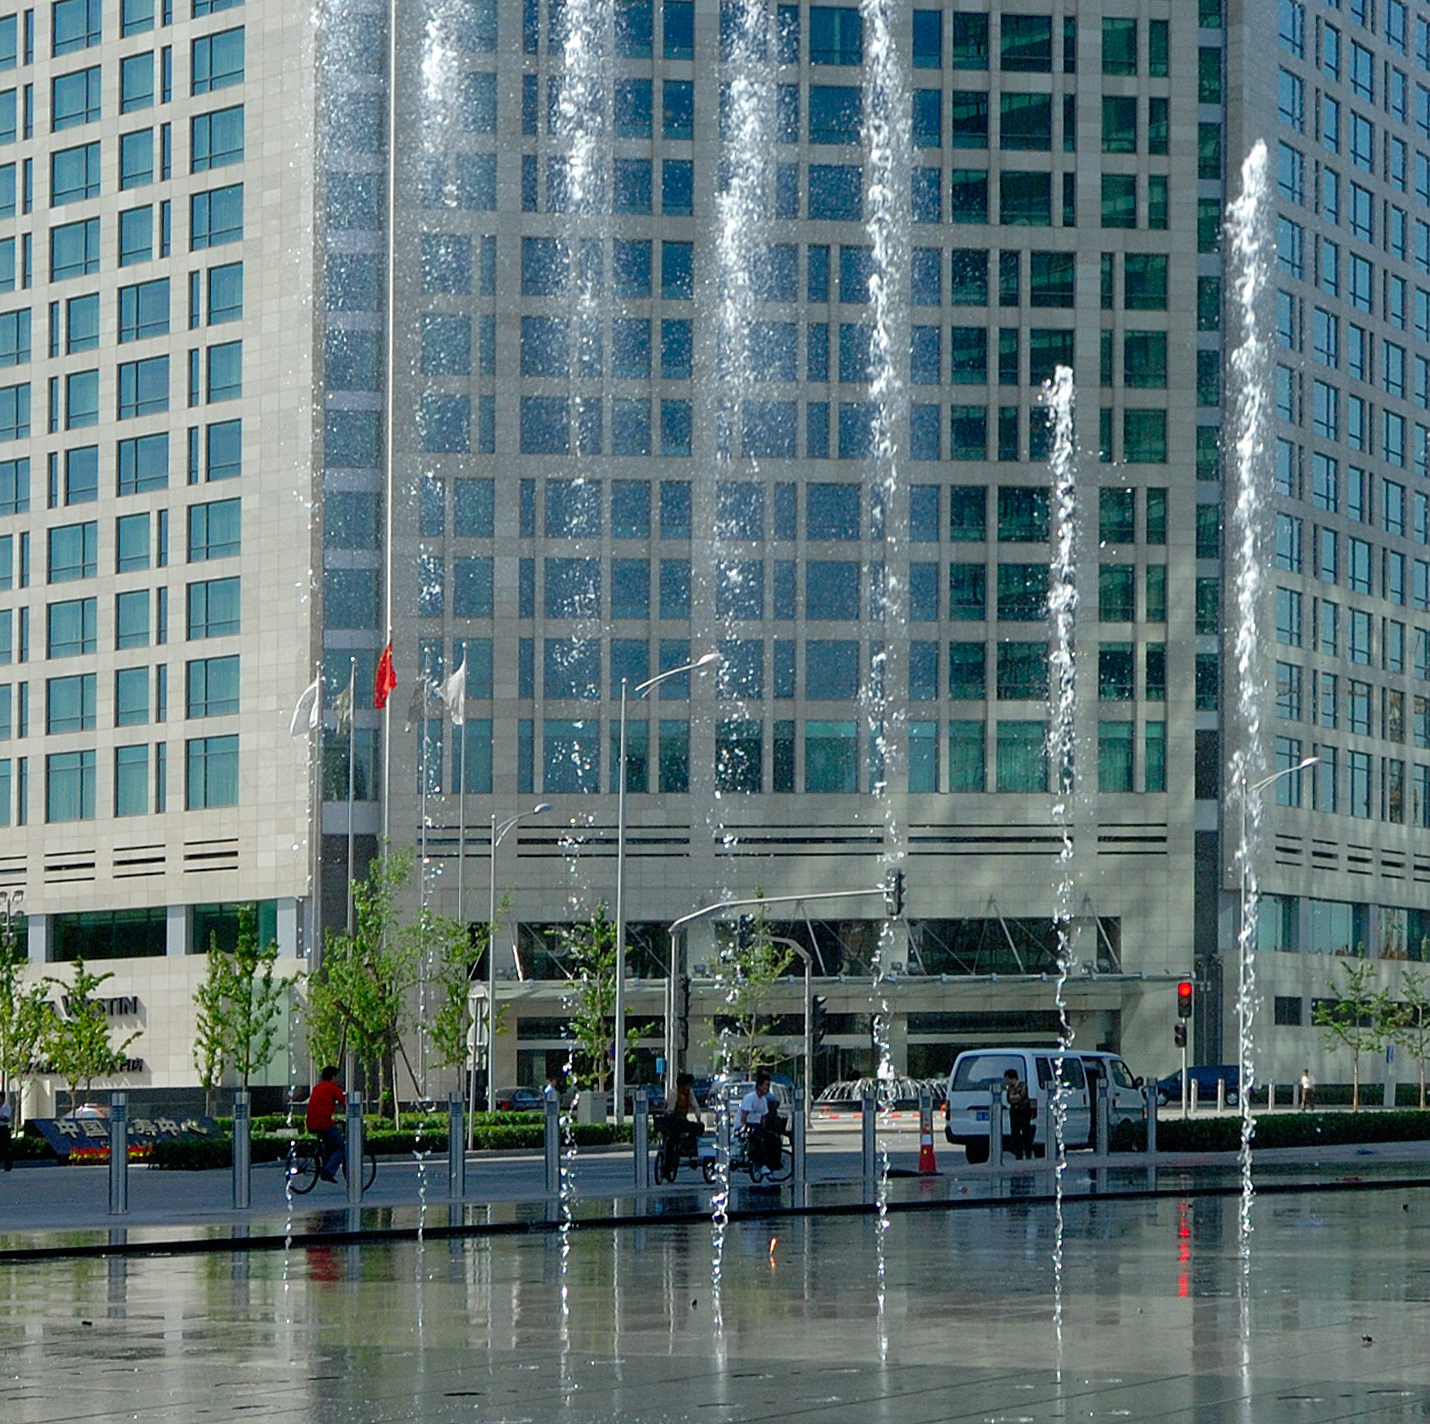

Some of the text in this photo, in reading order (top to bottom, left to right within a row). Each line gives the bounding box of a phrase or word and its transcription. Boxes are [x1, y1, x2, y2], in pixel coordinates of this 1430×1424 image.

[53, 1119, 207, 1139] 中国寿中心
